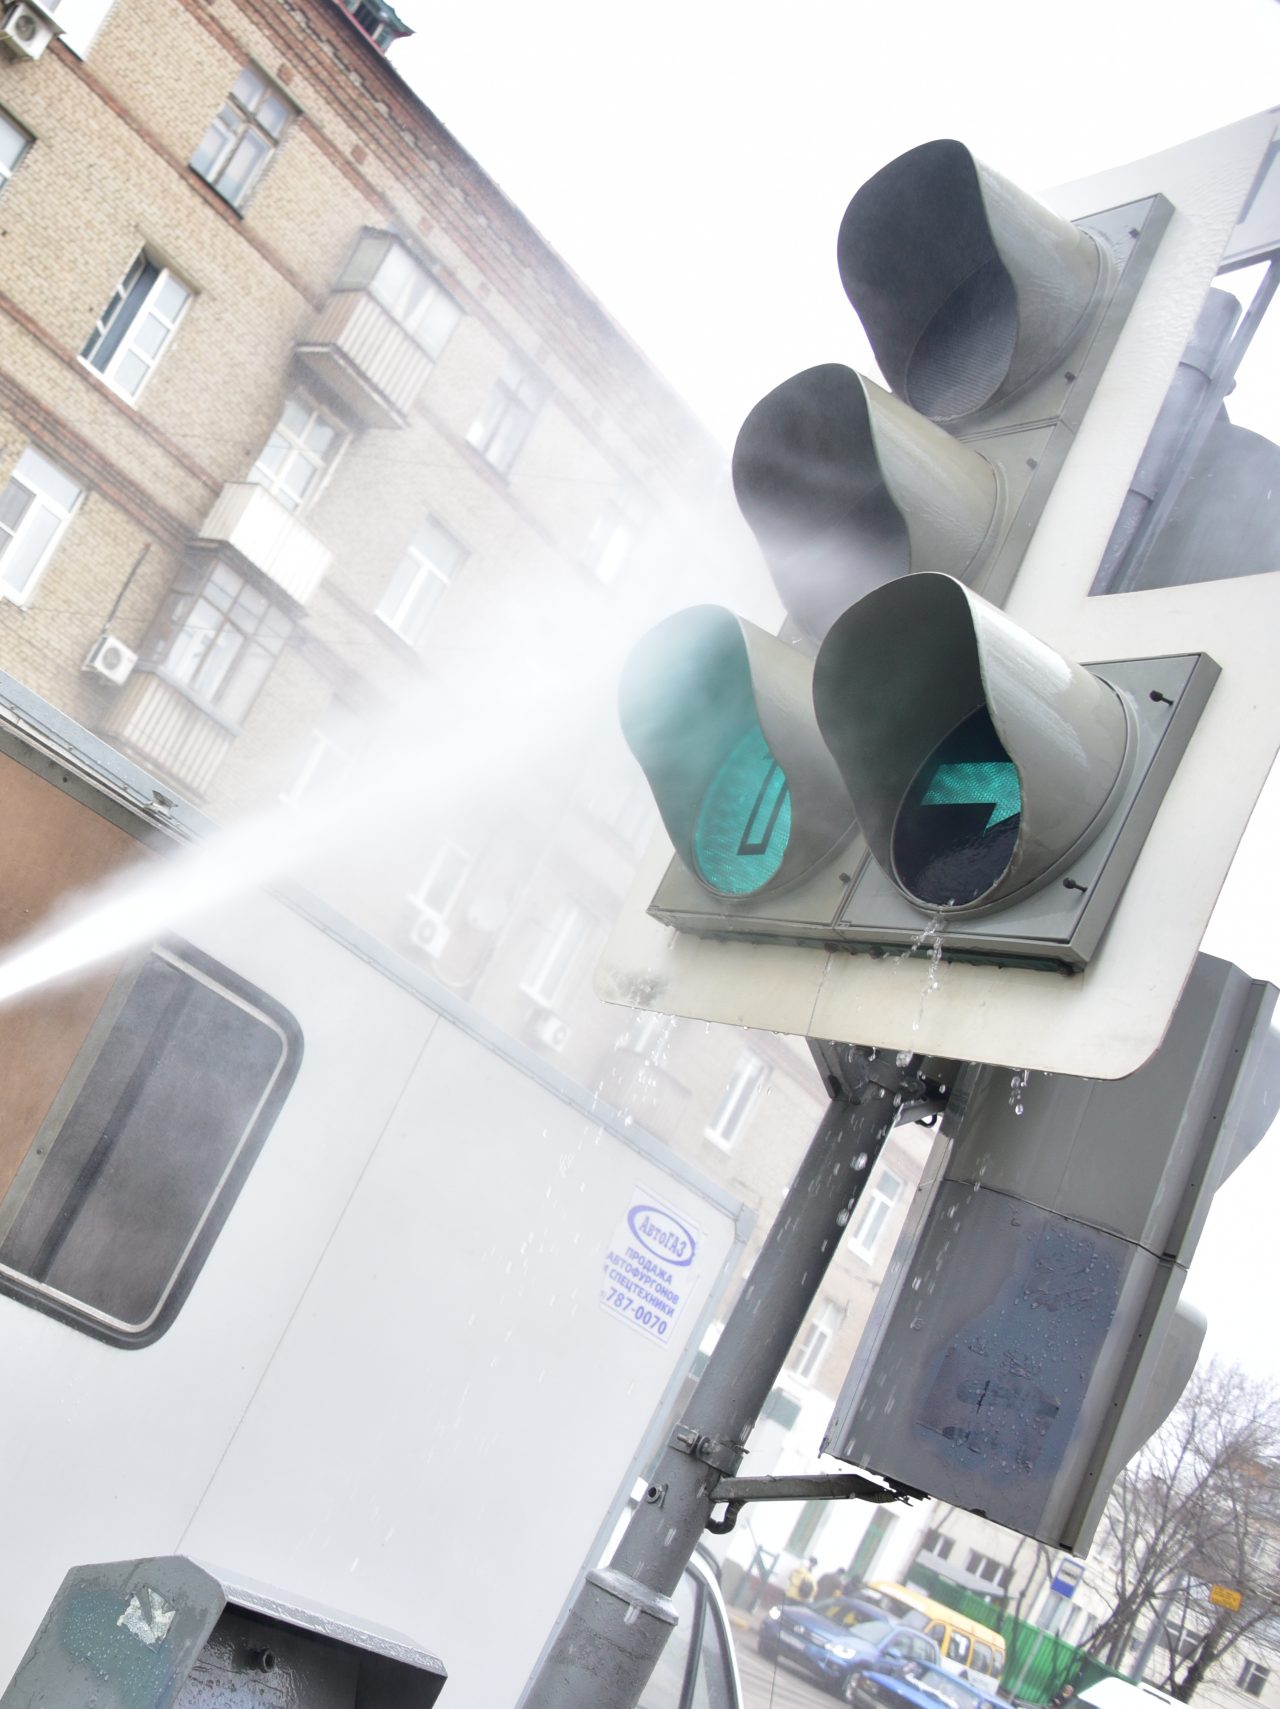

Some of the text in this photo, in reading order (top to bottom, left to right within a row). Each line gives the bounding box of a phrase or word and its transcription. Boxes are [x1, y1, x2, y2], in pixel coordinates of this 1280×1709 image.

[606, 1251, 680, 1305] АВТОФУРГОНОВ
[625, 1247, 673, 1285] ПРОДАЖА
[606, 1287, 668, 1335] 787-0070
[609, 1269, 675, 1318] СПЕЦТЕХНИКИ
